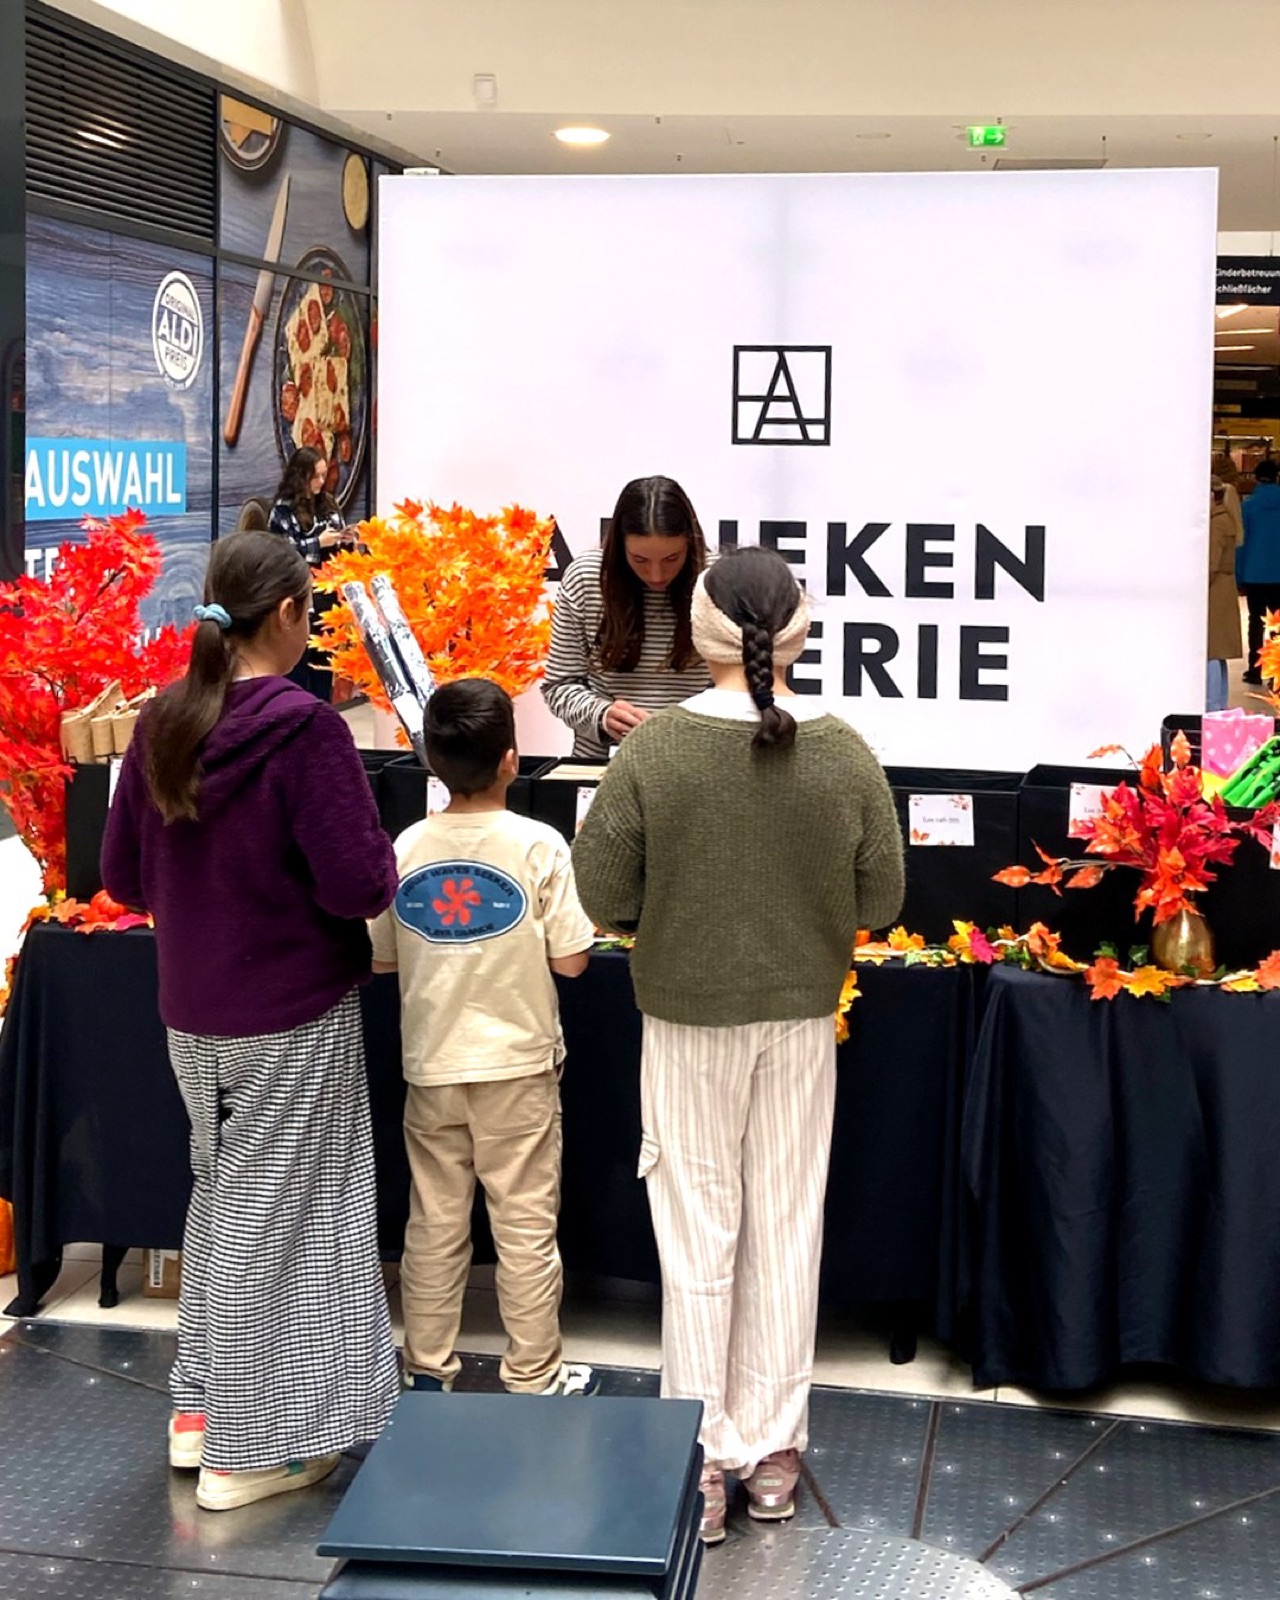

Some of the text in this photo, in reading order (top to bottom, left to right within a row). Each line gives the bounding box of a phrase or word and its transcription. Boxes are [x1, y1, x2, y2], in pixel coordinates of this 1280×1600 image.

[1216, 268, 1280, 277] inderbetreuun
[1216, 284, 1272, 294] chließfächer
[158, 308, 199, 358] ALDI
[25, 449, 181, 508] AUSWAHL
[541, 513, 1045, 602] AEKEN
[787, 620, 1009, 701] ERIE
